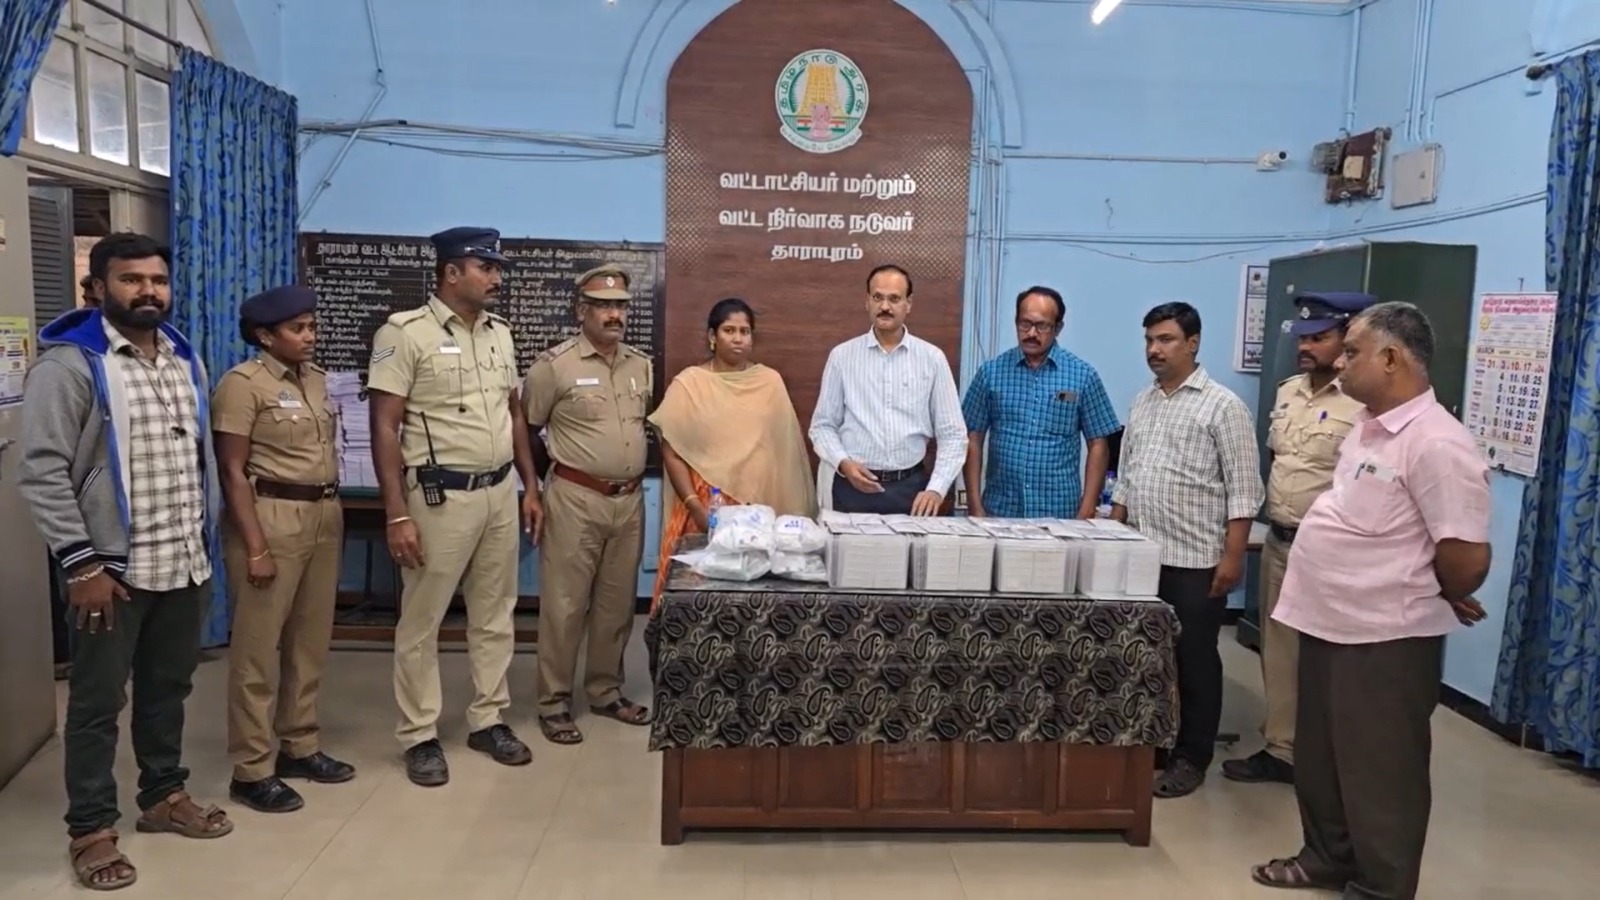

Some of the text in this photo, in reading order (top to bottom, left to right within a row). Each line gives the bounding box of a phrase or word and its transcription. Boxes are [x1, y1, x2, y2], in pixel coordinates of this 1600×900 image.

[720, 172, 916, 199] வட்டாட்சியர் மற்றும்
[719, 207, 914, 234] வட்ட நிர்வாக நடுவர்
[771, 244, 863, 262] தாராபுரம்
[1487, 359, 1495, 369] 31
[1500, 360, 1506, 370] 3
[1511, 361, 1519, 371] 10
[1524, 362, 1532, 371] 17
[1500, 372, 1504, 380] 4
[1510, 374, 1518, 383] 11
[1522, 375, 1530, 384] 18
[1533, 376, 1542, 386] 25
[1498, 383, 1503, 393] 5
[1509, 385, 1516, 394] 12
[1519, 387, 1527, 396] 19
[1531, 387, 1540, 397] 26
[1496, 395, 1501, 404] 6
[1506, 396, 1514, 406] 13
[1529, 400, 1538, 409] 27
[1496, 406, 1500, 415] 7
[1505, 408, 1513, 417] 14
[1516, 410, 1524, 419] 21
[1504, 419, 1511, 429] 15
[1514, 421, 1523, 431] 22
[1480, 426, 1485, 436] 2
[1502, 431, 1509, 440] 16
[1524, 435, 1532, 445] 30
